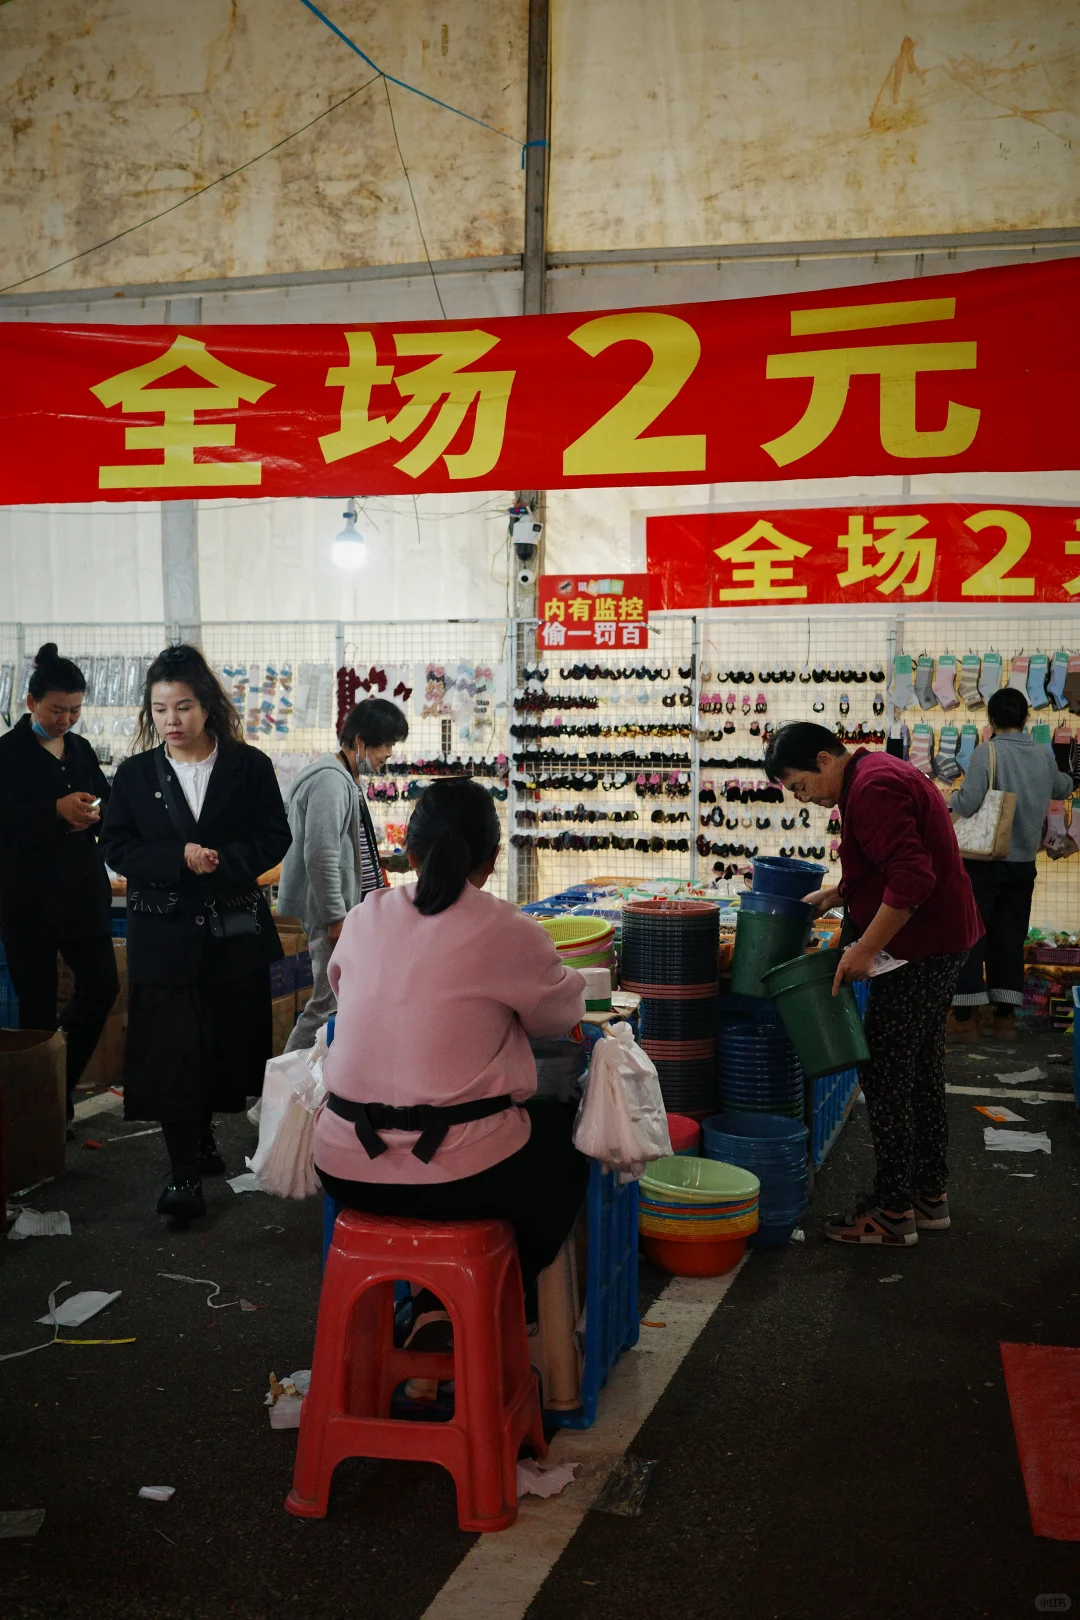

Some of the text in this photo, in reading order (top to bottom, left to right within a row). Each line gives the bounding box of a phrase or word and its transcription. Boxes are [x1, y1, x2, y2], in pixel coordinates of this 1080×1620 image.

[91, 297, 980, 488] 全场2元
[715, 510, 1080, 602] 全场2
[542, 621, 643, 646] 偷一罚百
[544, 597, 644, 622] 内有监控
